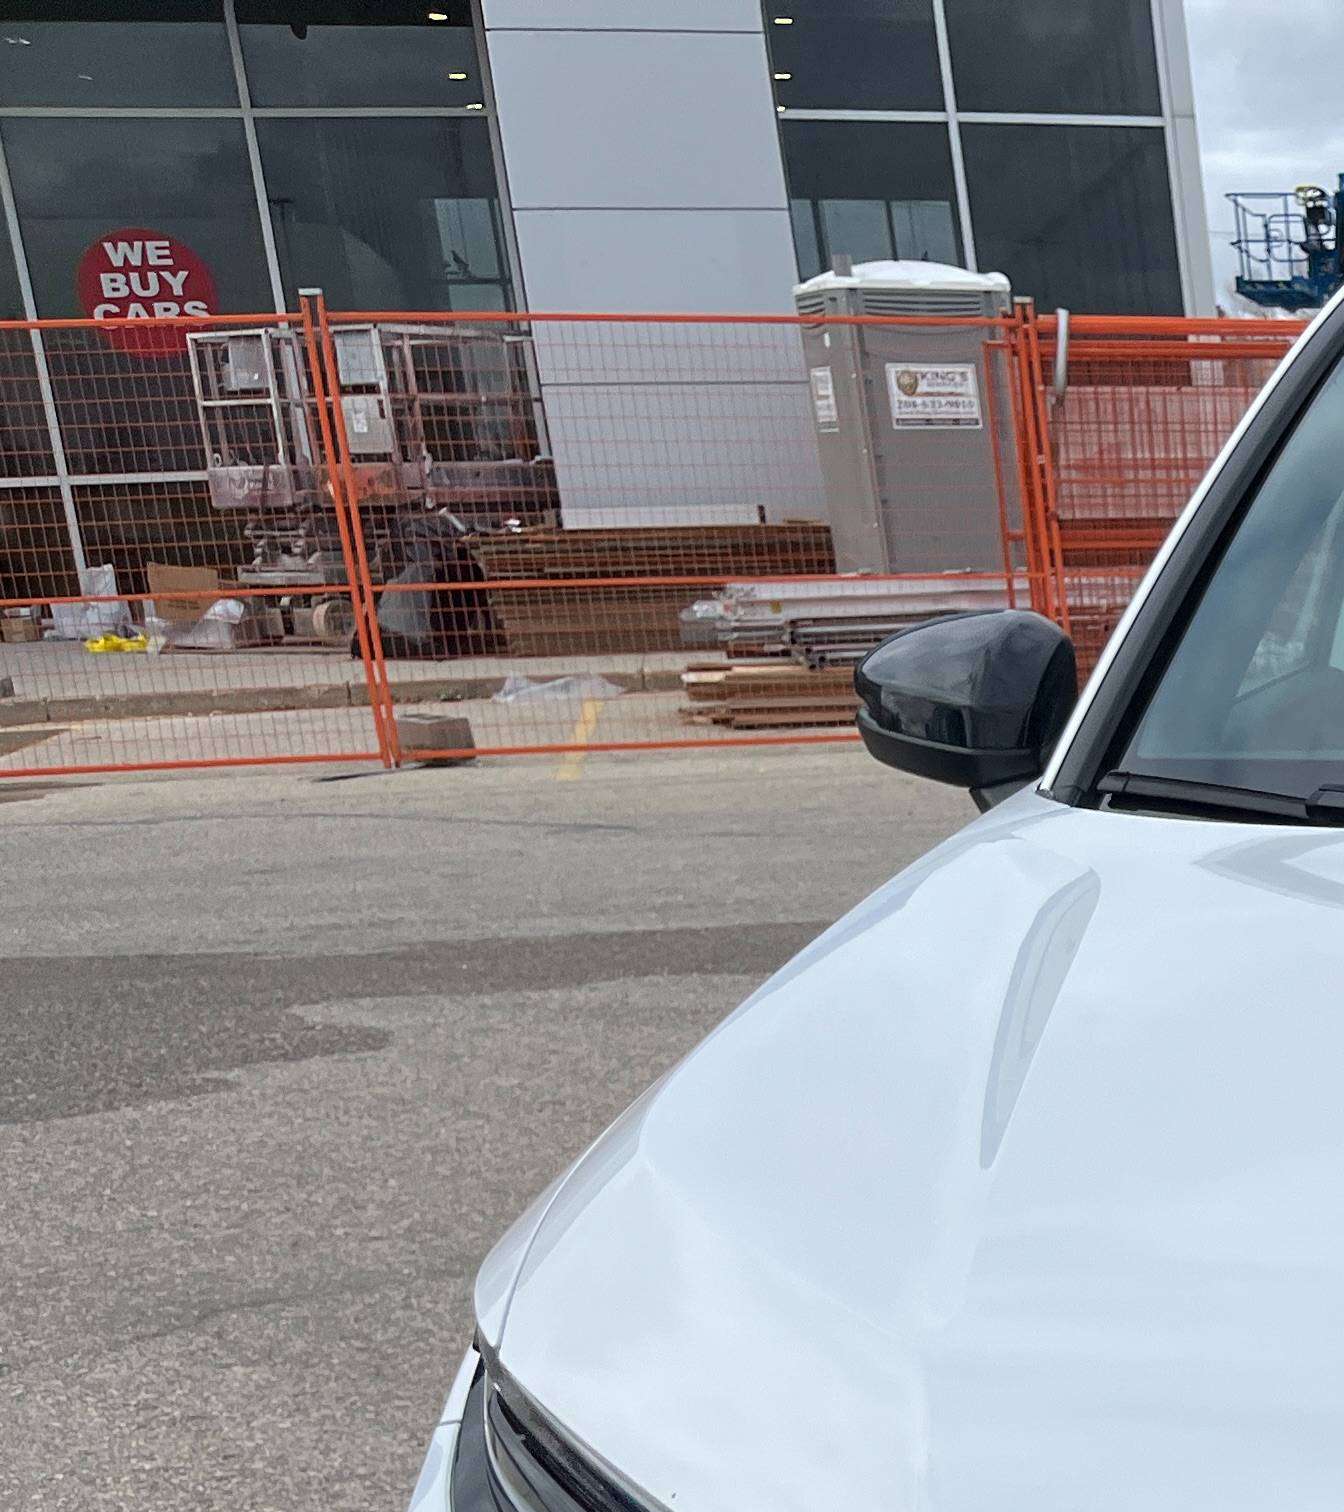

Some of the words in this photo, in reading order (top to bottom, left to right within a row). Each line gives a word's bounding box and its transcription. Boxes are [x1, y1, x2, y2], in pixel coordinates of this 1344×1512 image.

[102, 240, 174, 267] WE
[99, 270, 189, 298] BUY
[93, 300, 211, 330] CARS
